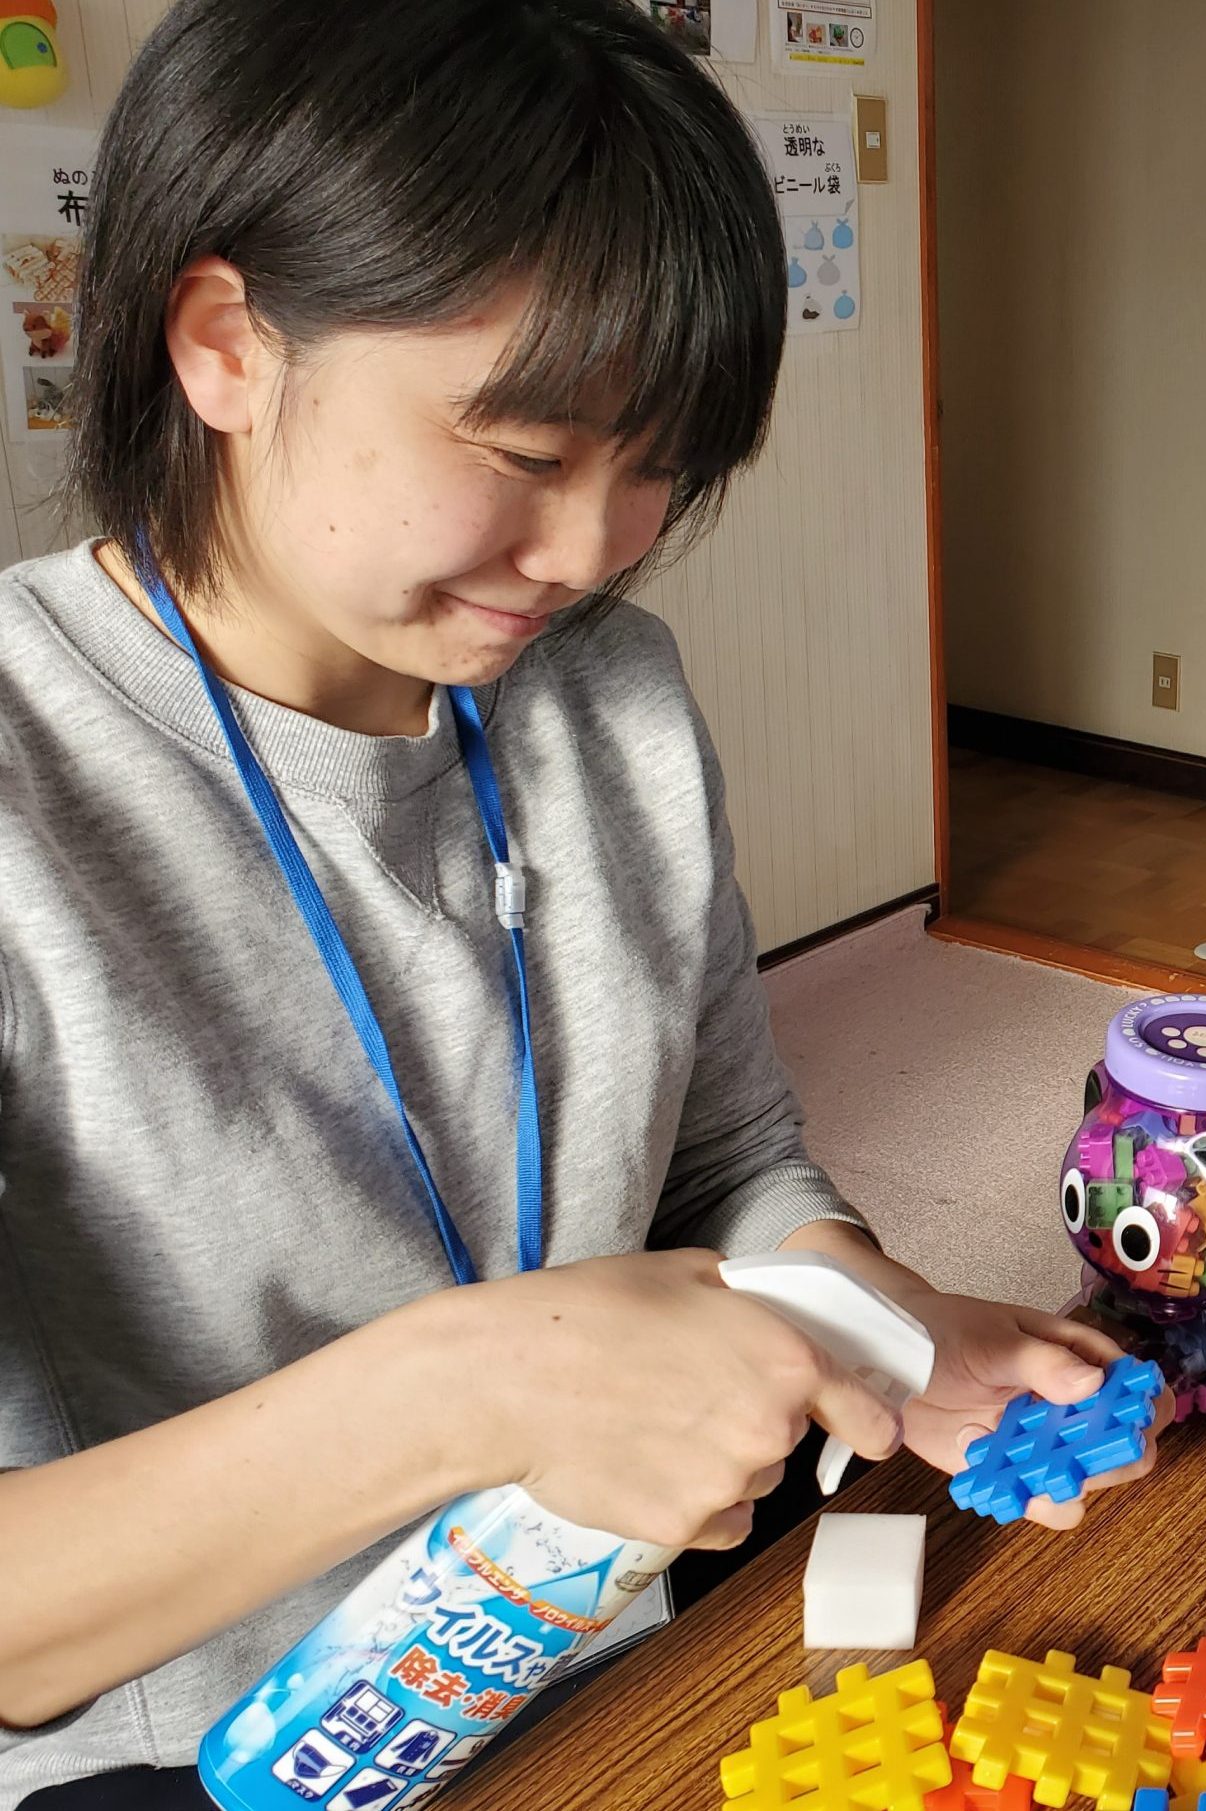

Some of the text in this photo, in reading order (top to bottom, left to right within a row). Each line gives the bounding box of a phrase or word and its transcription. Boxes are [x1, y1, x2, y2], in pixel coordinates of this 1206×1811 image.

[783, 124, 810, 134] とうめい
[784, 136, 826, 157] 透明な
[53, 168, 96, 185] ぬの
[774, 175, 841, 195] ビニール袋
